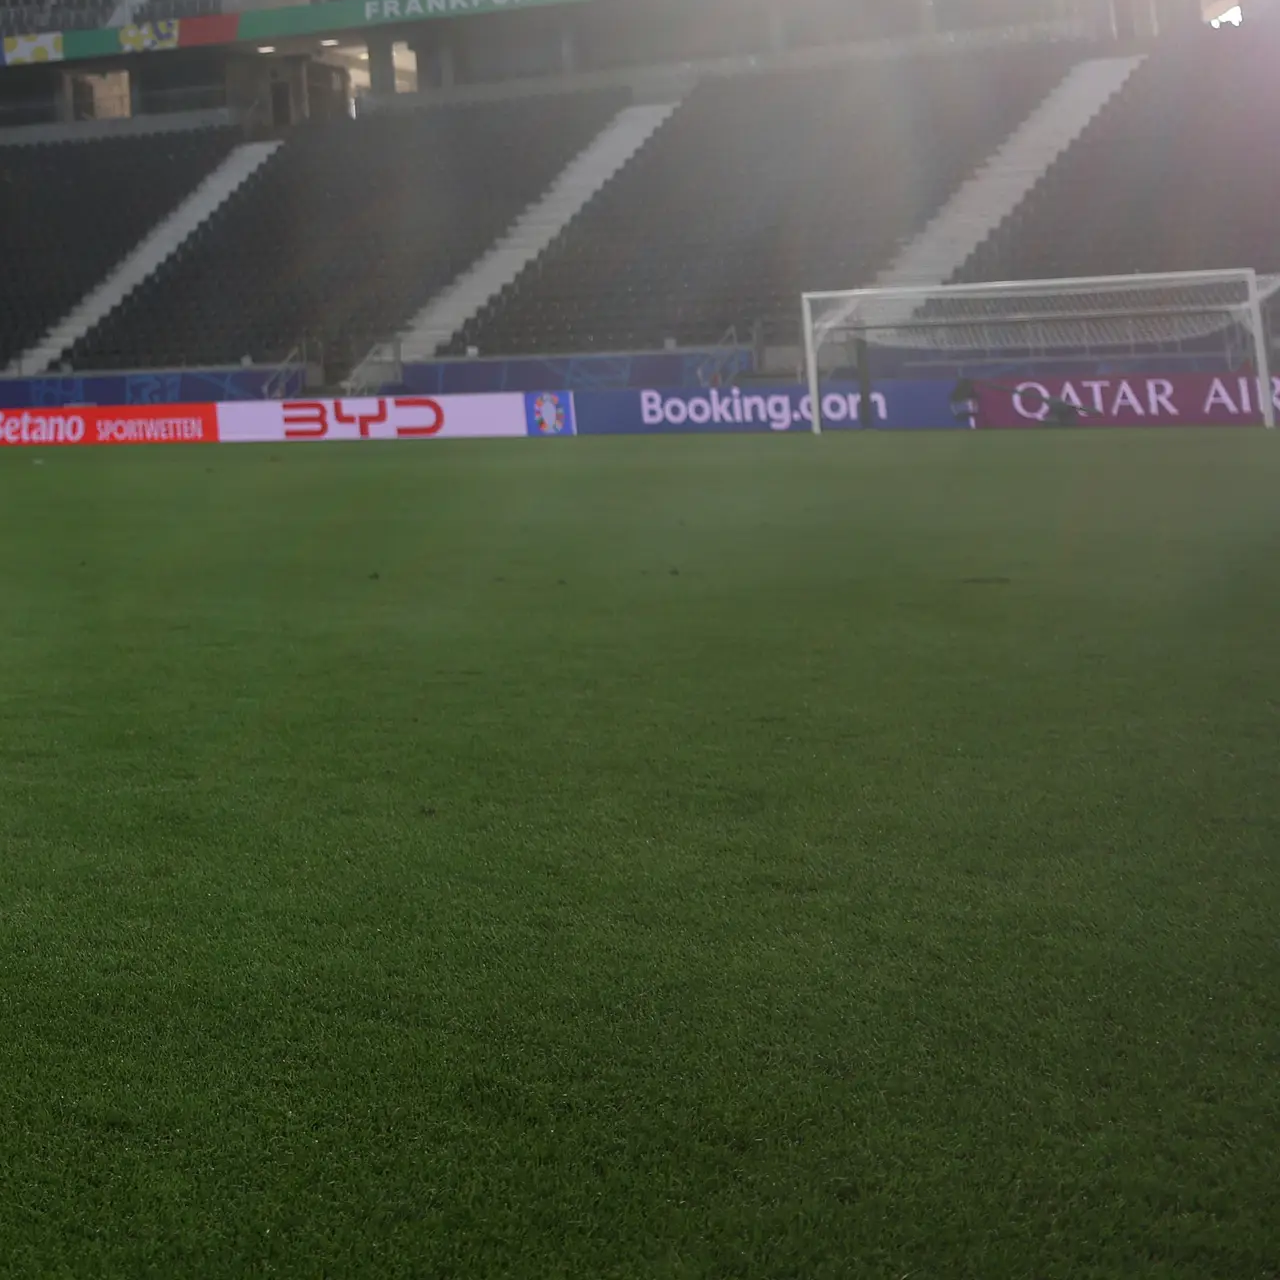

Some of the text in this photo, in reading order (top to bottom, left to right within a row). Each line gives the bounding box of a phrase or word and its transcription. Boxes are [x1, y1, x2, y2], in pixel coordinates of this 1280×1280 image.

[282, 397, 445, 438] BYD
[1011, 378, 1180, 422] QATAR
[95, 417, 204, 442] SPORTWETTEN
